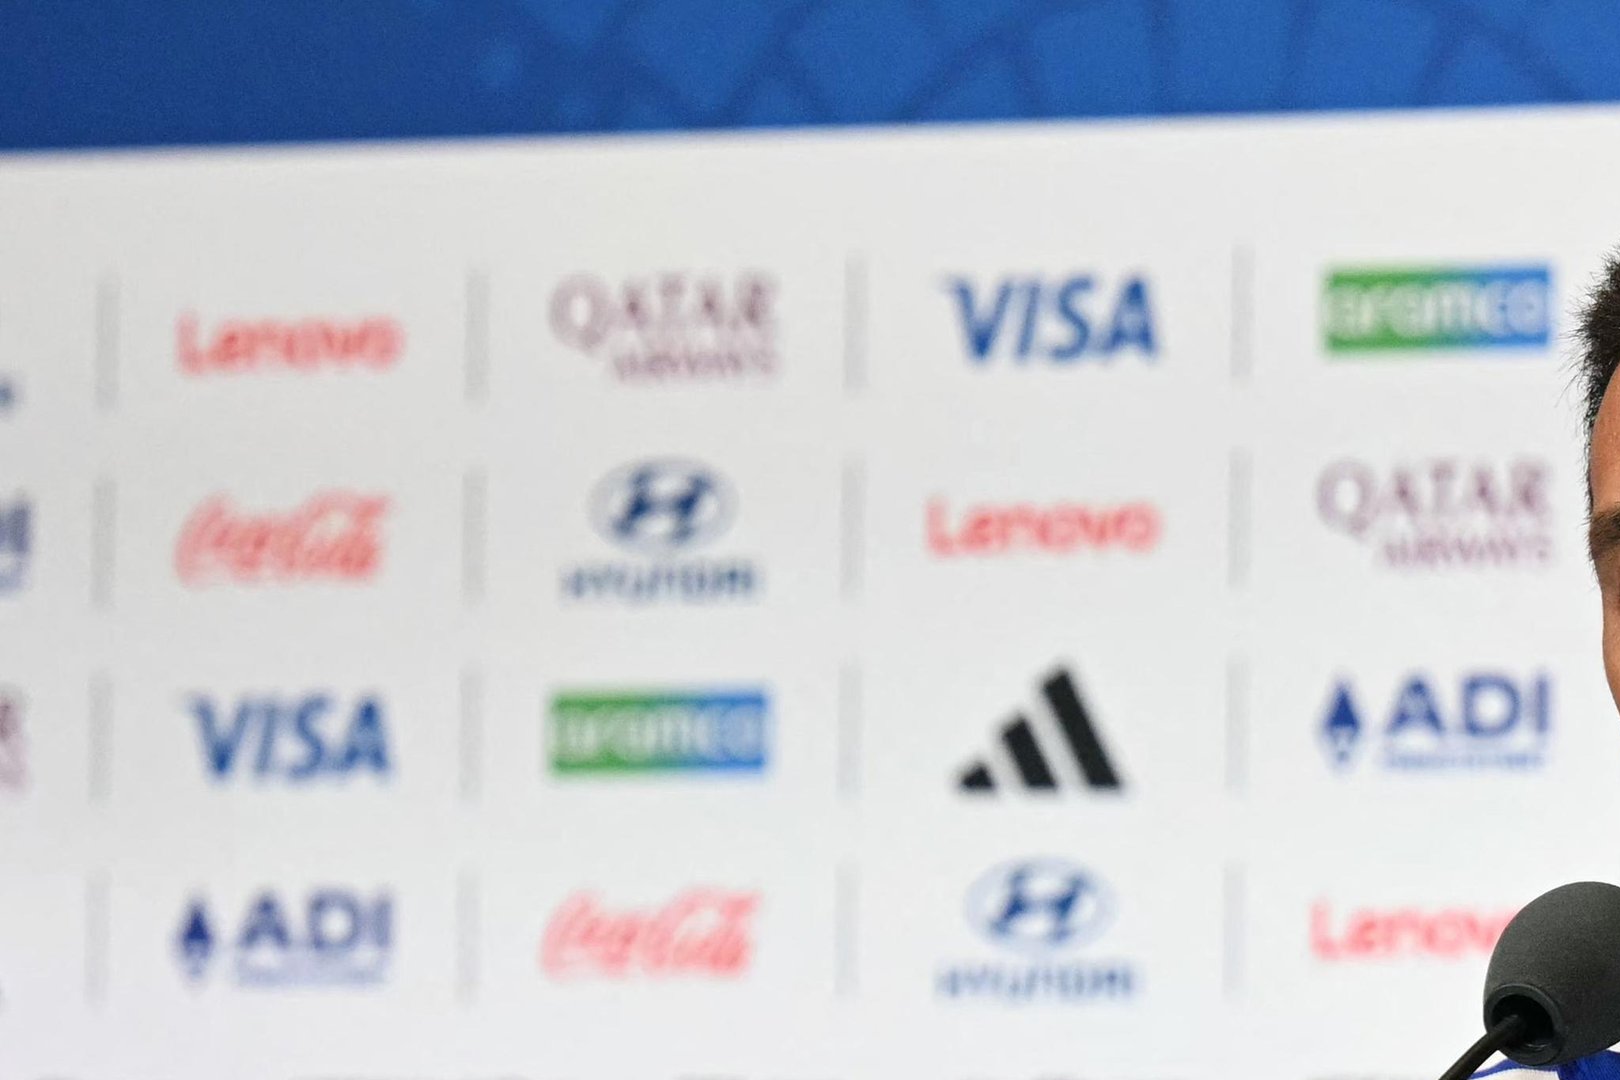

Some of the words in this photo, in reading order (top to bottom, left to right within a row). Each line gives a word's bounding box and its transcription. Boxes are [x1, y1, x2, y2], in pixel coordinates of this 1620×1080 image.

[945, 275, 1159, 362] VISA
[925, 499, 1161, 556] Lenovo
[1316, 460, 1551, 537] QATAR
[1383, 672, 1551, 737] ADI
[188, 694, 392, 782] VISA
[234, 889, 394, 950] ADI
[1310, 904, 1514, 957] Lenov
